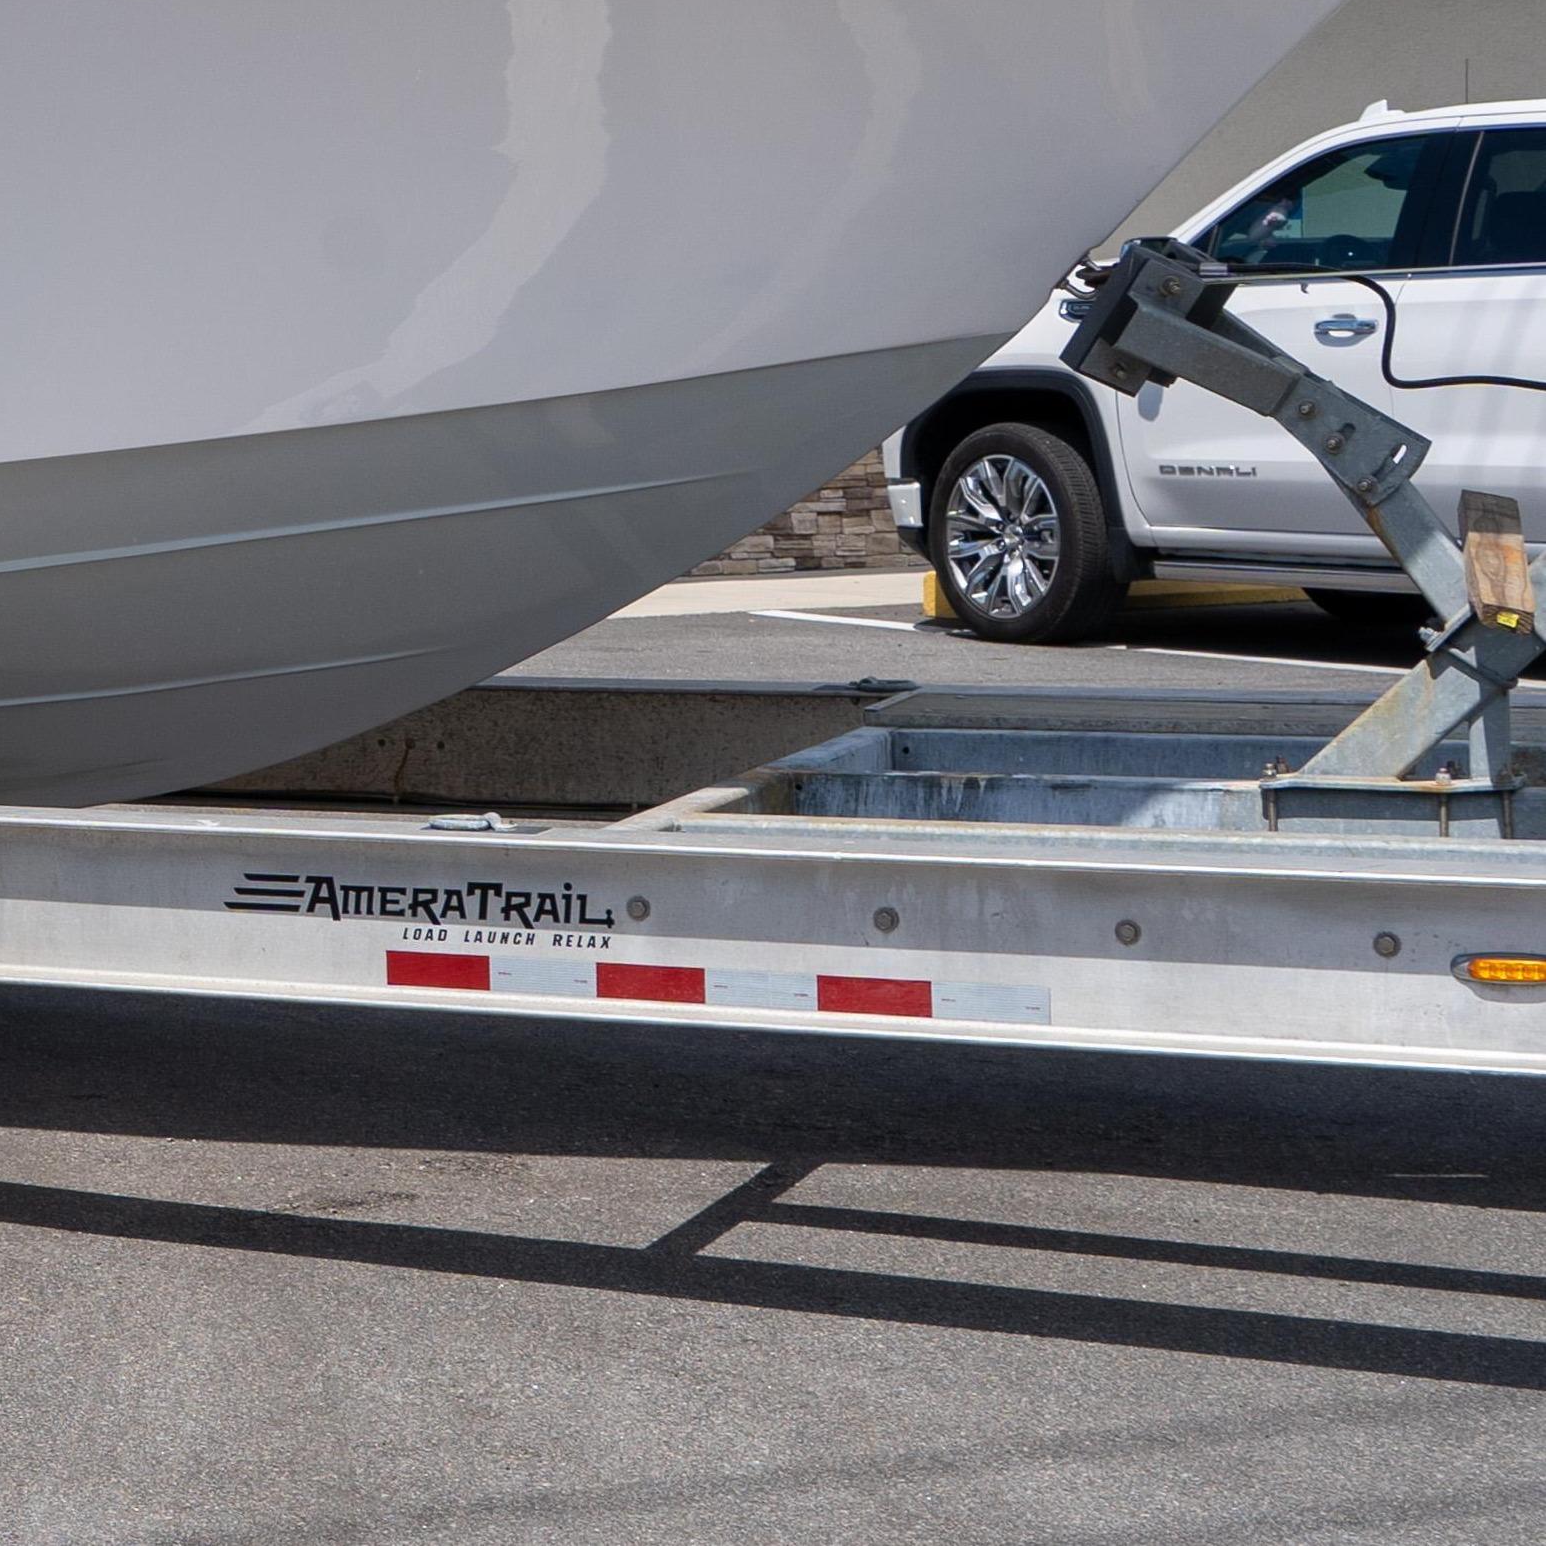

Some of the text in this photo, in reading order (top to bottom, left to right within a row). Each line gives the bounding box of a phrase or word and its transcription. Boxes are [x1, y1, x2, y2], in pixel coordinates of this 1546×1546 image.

[1159, 464, 1257, 477] DENALI
[402, 927, 612, 950] LOAD LAUNCH RELAX
